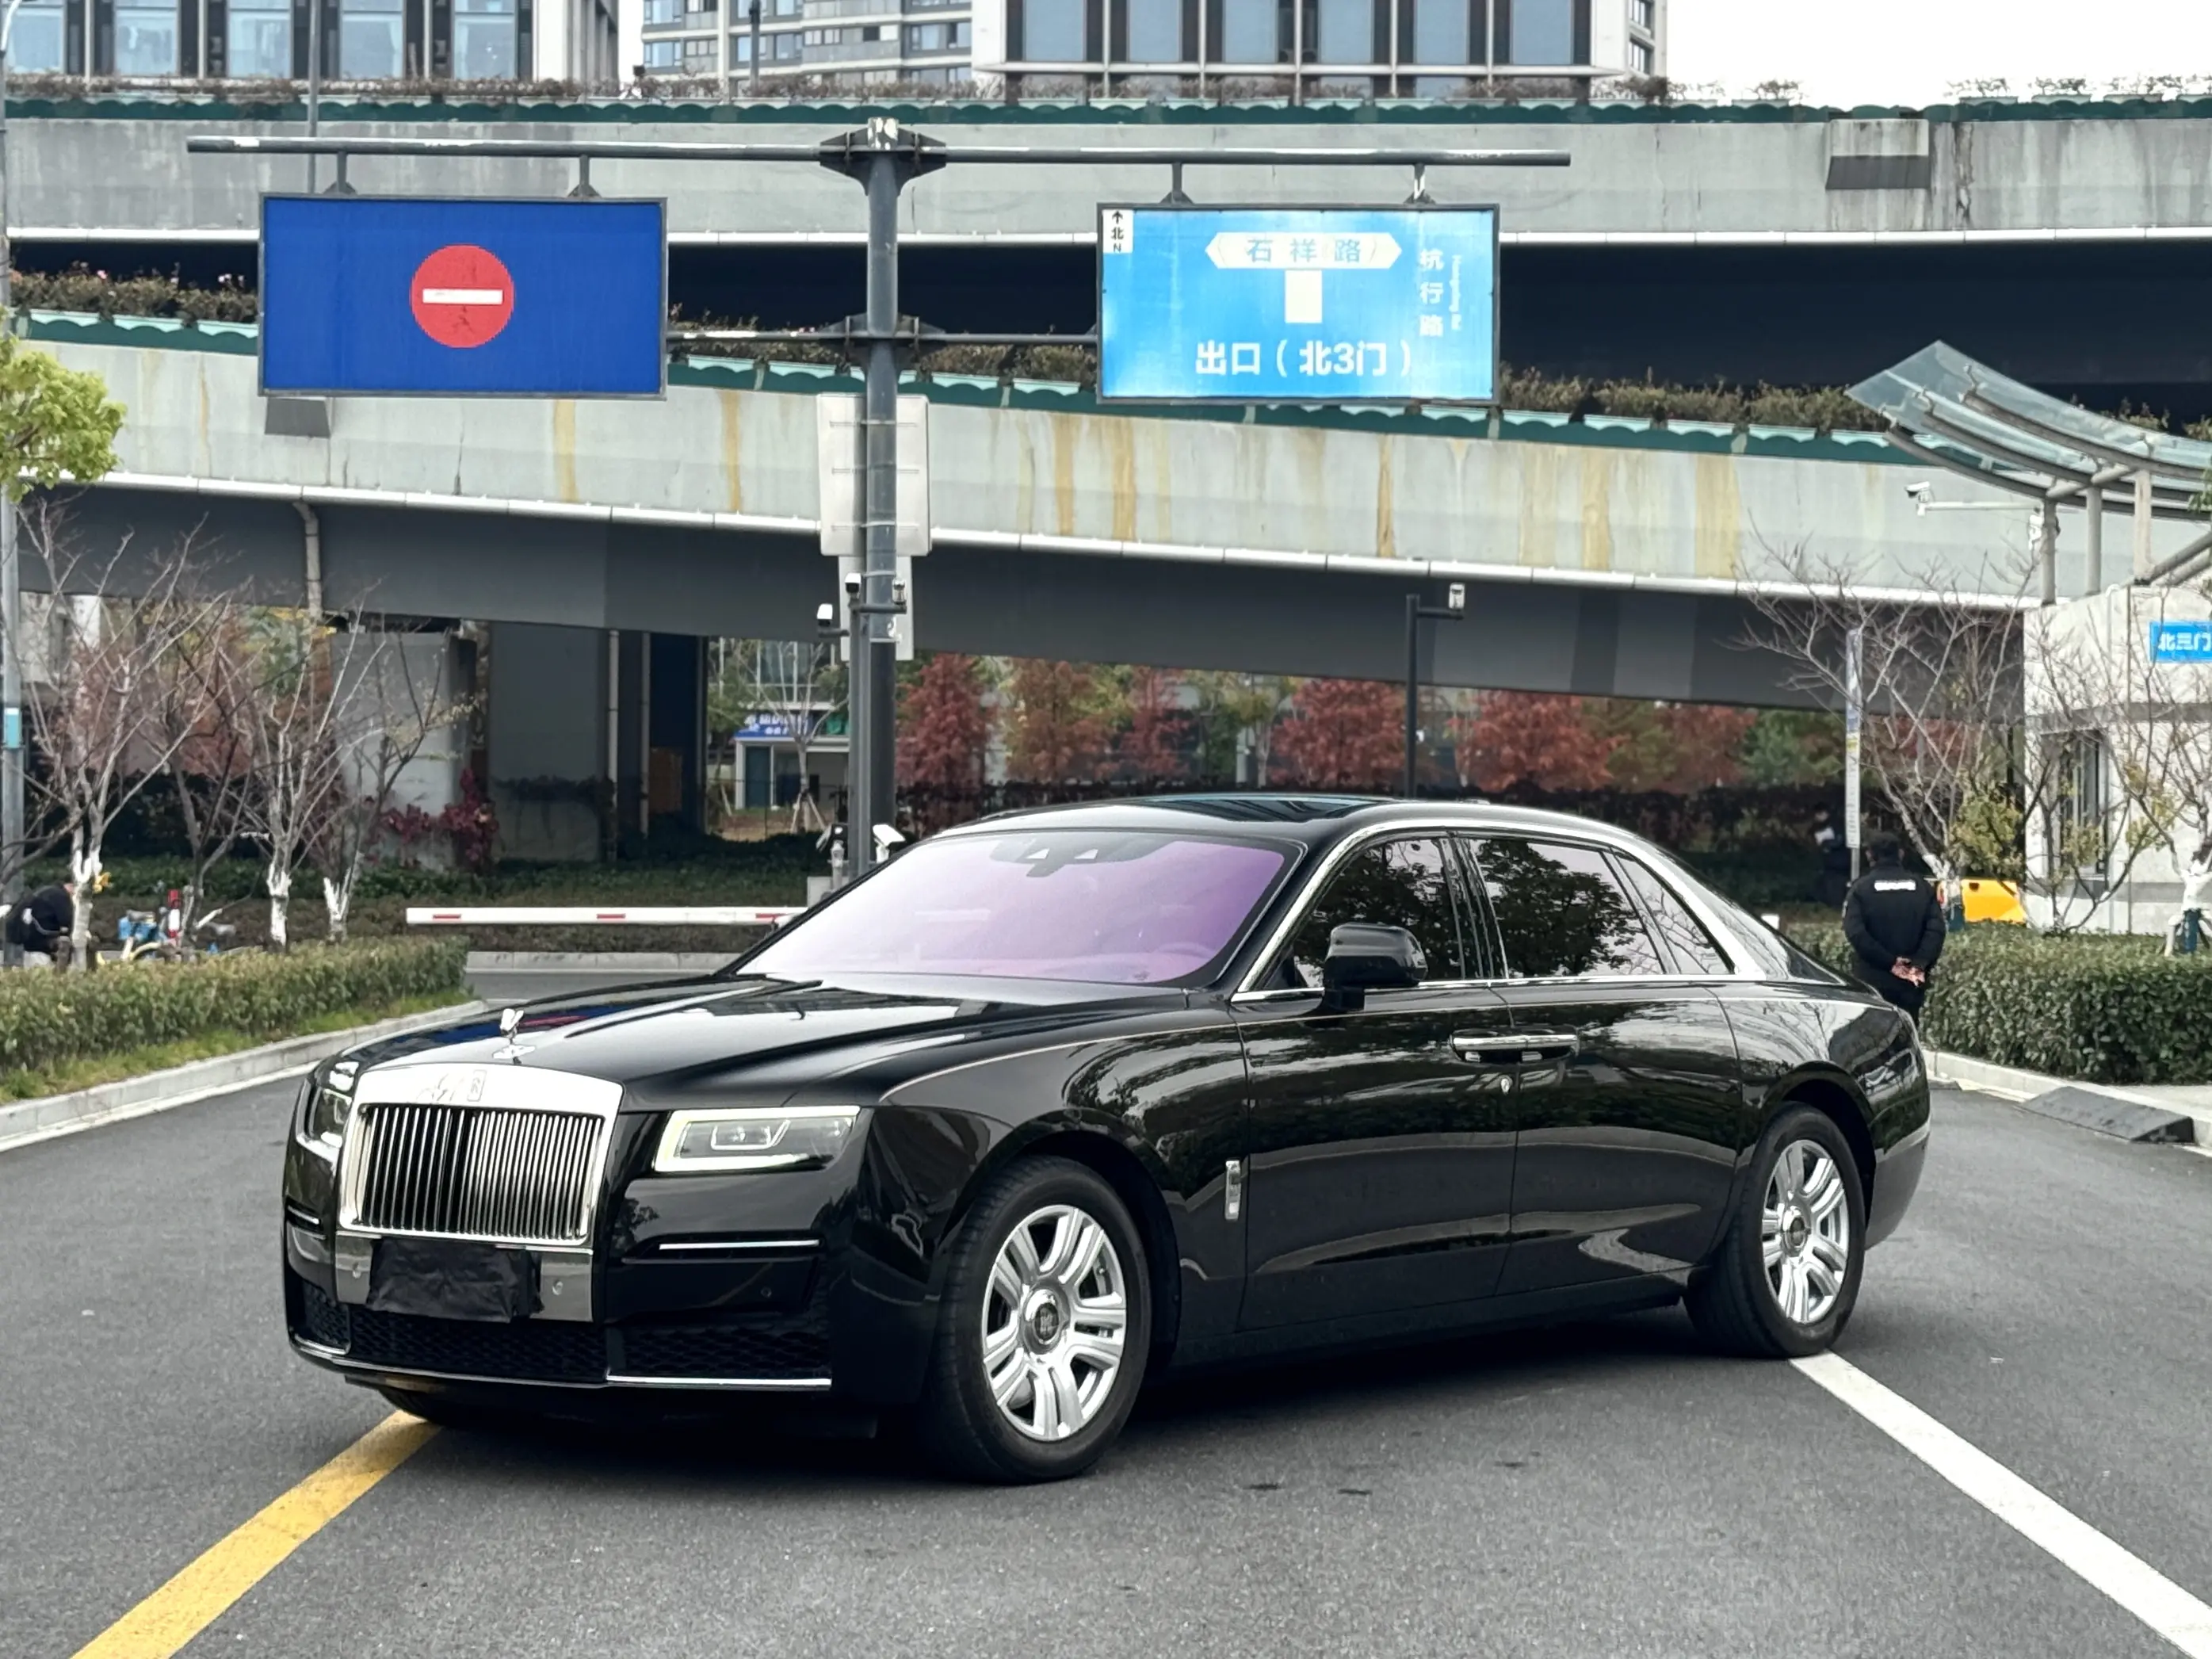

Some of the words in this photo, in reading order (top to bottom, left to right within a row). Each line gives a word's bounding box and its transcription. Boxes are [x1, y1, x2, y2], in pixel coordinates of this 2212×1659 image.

[1110, 226, 1125, 240] 北
[1113, 243, 1122, 253] N
[1246, 238, 1362, 263] 石祥路
[2158, 631, 2211, 652] 北三门
